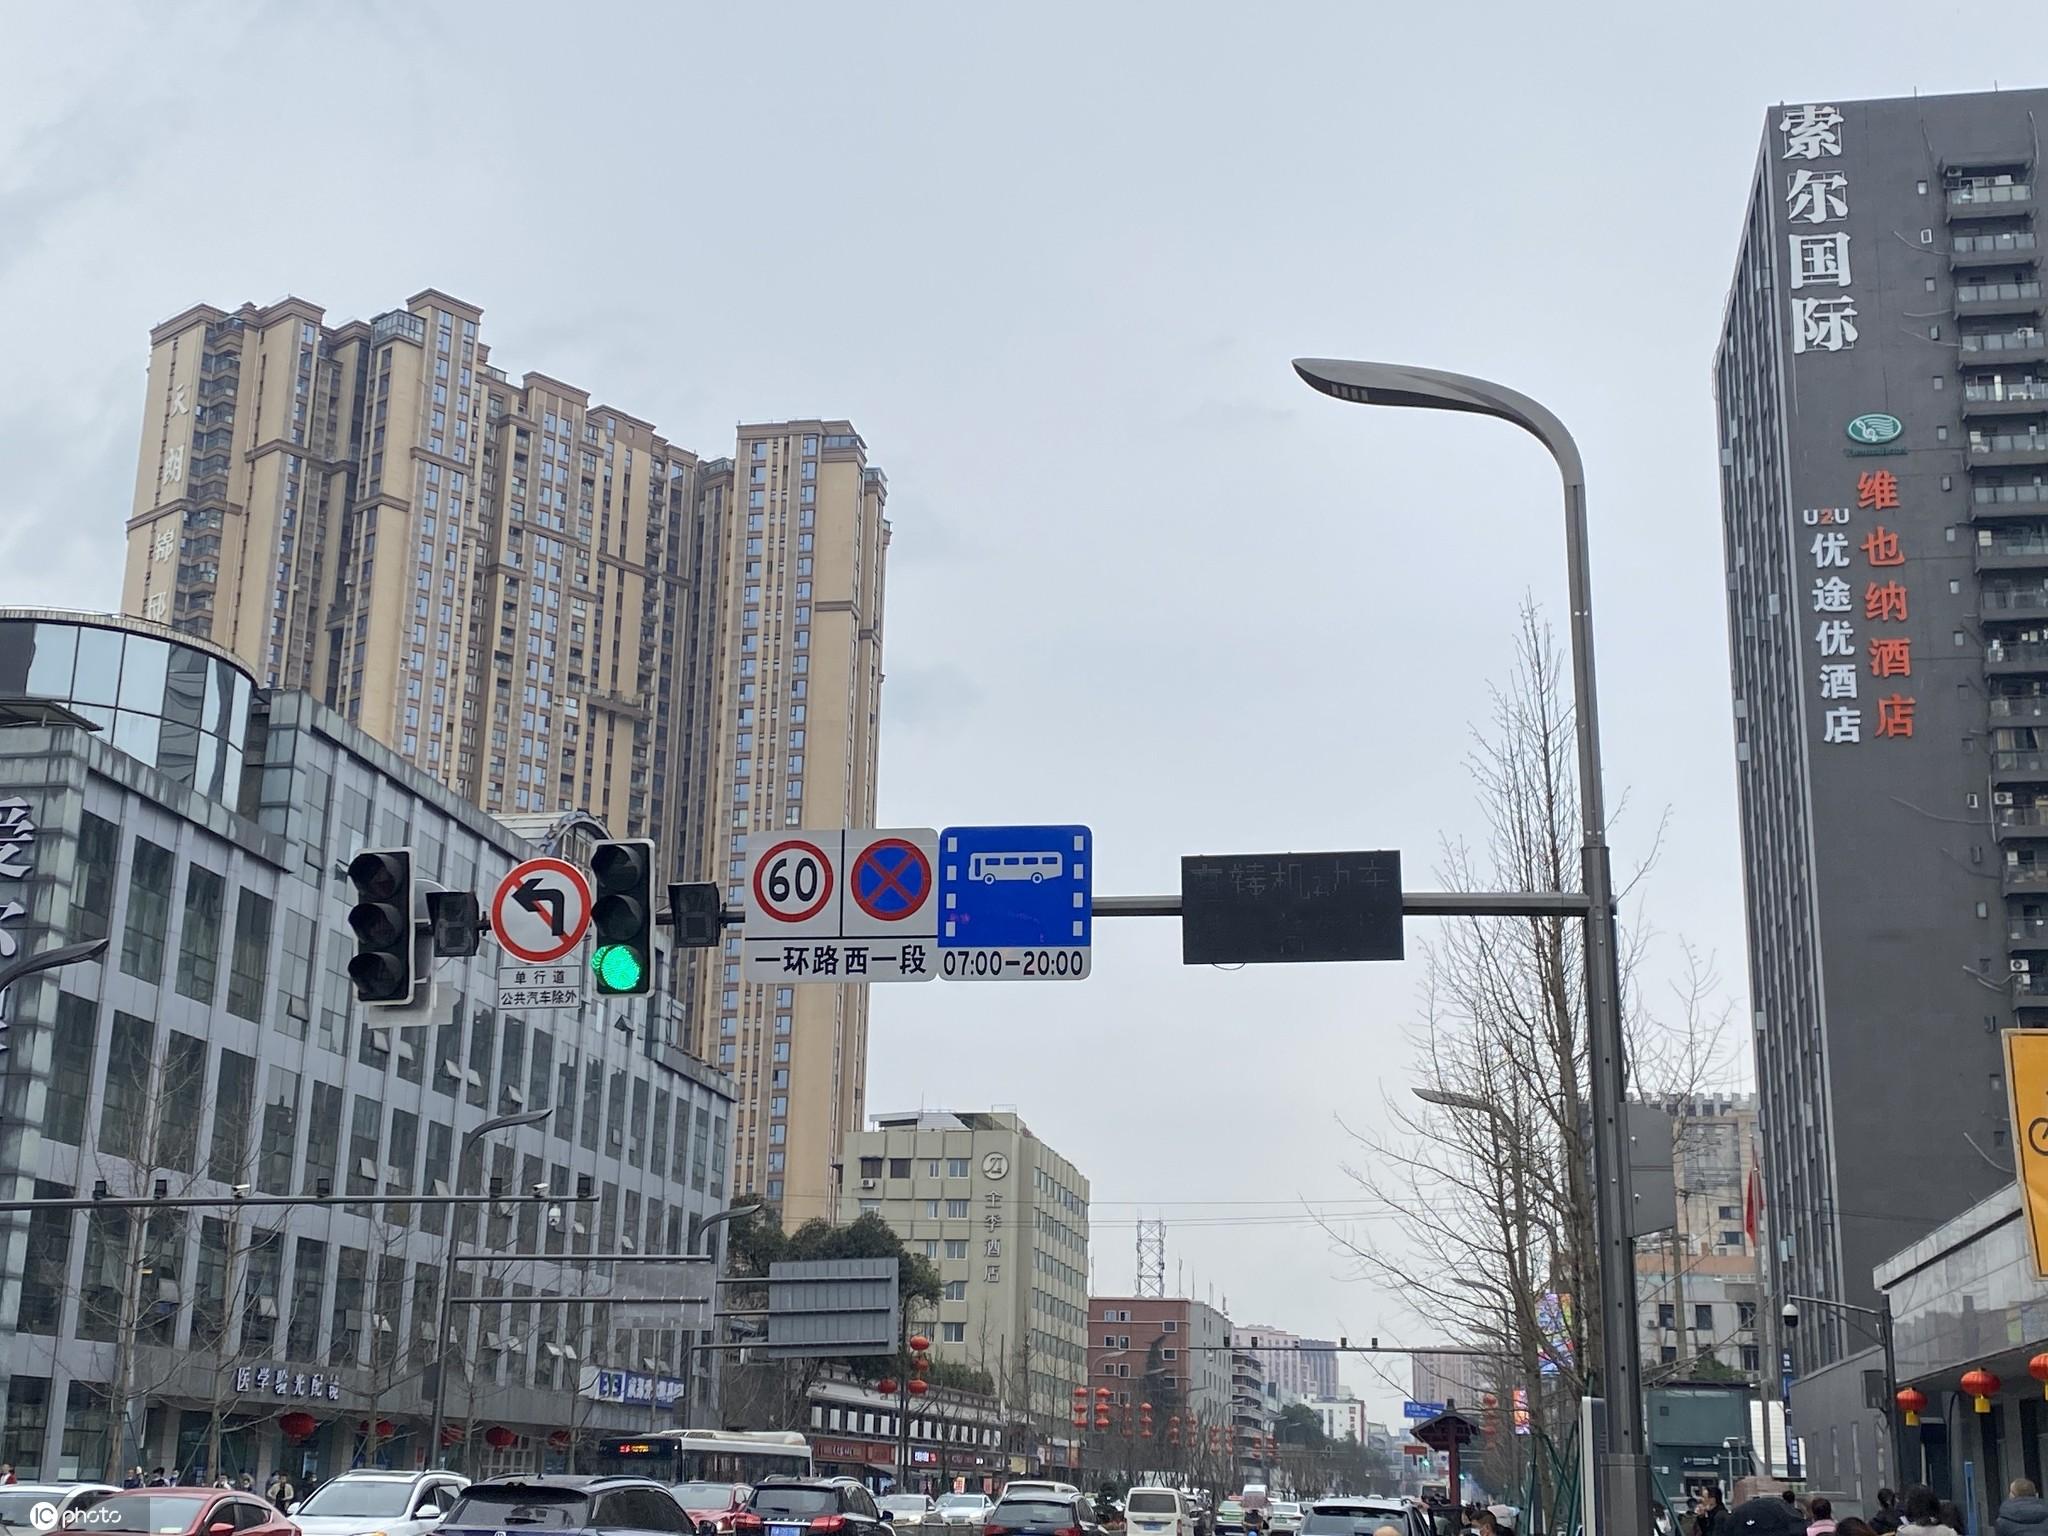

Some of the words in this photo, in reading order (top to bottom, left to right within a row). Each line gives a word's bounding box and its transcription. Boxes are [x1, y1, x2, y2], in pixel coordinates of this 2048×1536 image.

[1779, 106, 1858, 354] 索尔国际
[1803, 508, 1850, 526] U2U
[1856, 469, 1916, 738] 维也纳酒店
[1809, 532, 1861, 744] 优途优酒店
[768, 857, 819, 903] 60
[514, 970, 565, 985] 单行道
[755, 944, 927, 976] 一环路西一段
[501, 989, 577, 1006] 公共汽车除外
[984, 1190, 1003, 1283] 全季酒店
